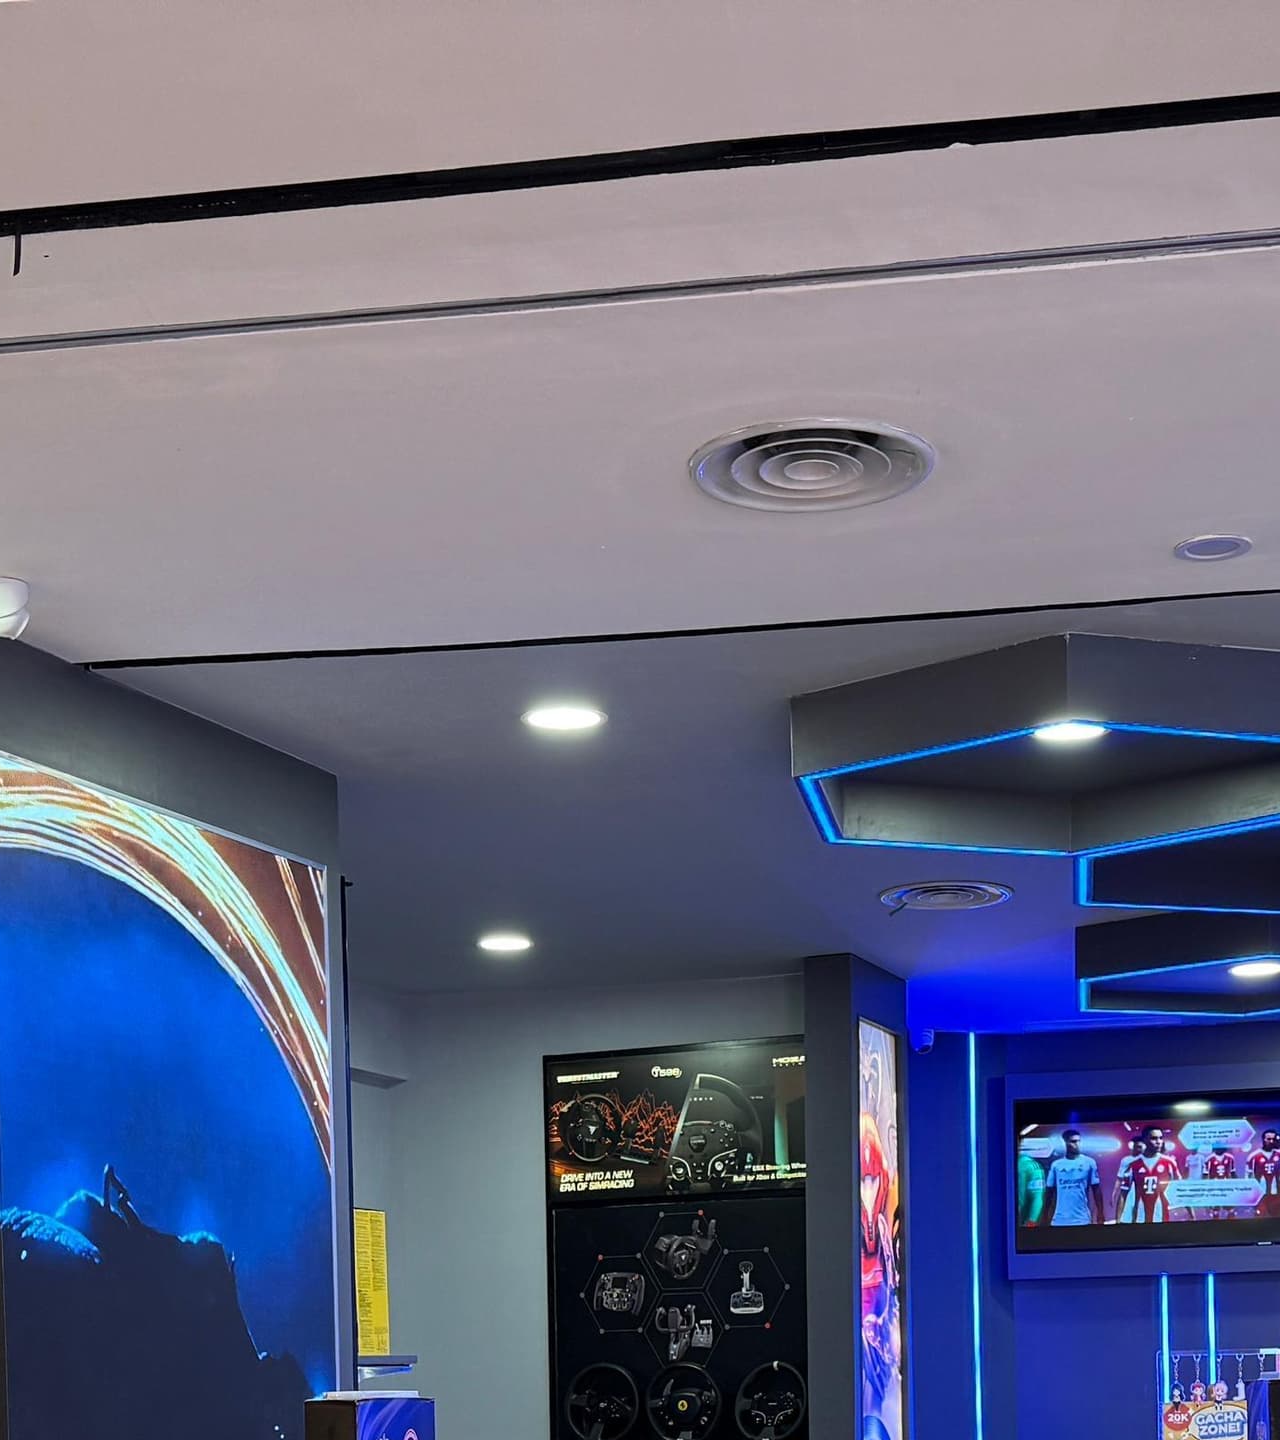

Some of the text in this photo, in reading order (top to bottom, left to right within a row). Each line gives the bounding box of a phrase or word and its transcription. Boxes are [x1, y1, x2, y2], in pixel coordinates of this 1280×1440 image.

[561, 1170, 633, 1183] DRIVE INTO A NEW
[560, 1183, 576, 1192] ERA
[577, 1182, 588, 1191] OF
[1168, 1413, 1189, 1422] 20K
[1196, 1410, 1245, 1426] GACHA
[1199, 1422, 1240, 1436] ZONE!
